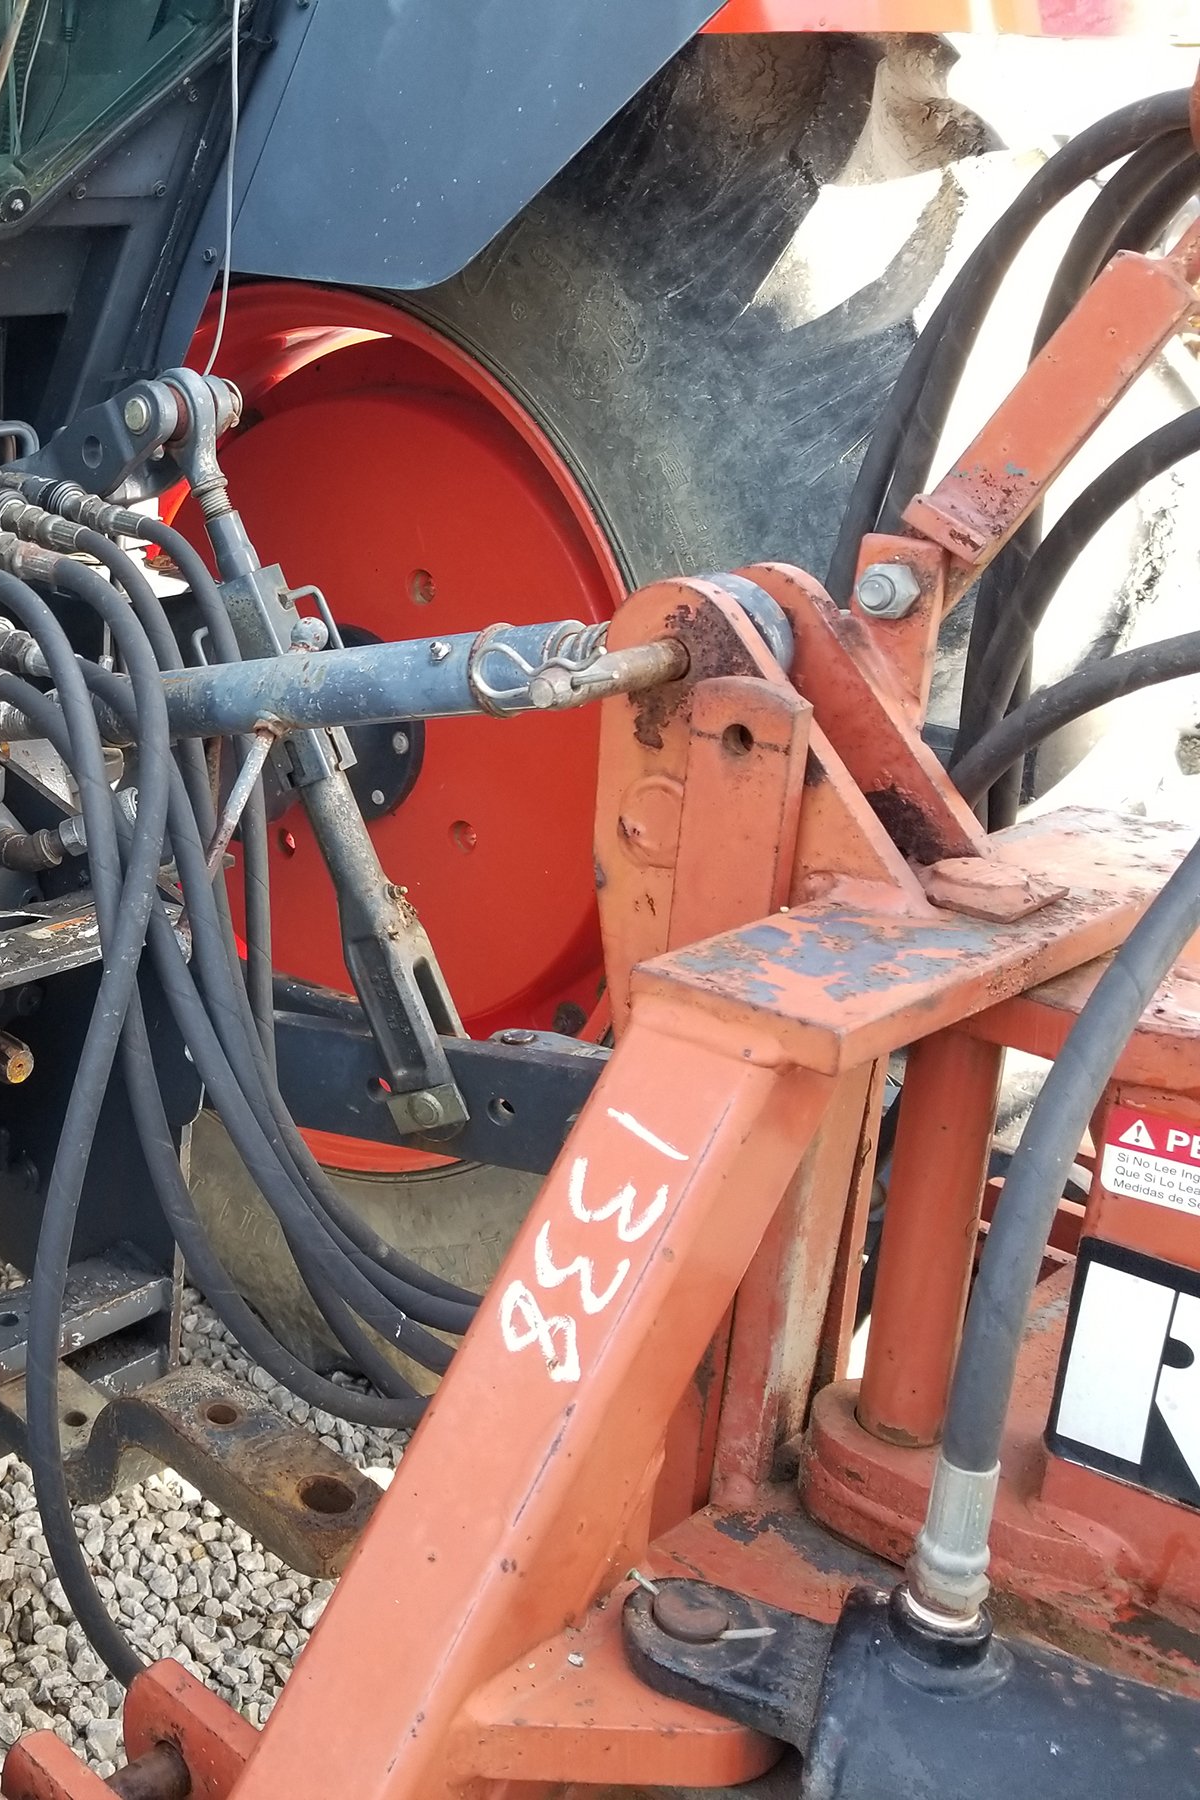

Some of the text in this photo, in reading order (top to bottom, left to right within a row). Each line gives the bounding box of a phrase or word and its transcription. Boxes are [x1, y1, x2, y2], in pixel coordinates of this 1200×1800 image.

[1117, 1152, 1130, 1163] Si
[1133, 1156, 1150, 1169] No
[1154, 1162, 1177, 1176] Lee
[1115, 1165, 1140, 1179] Que
[1144, 1172, 1157, 1184] Si
[1160, 1177, 1175, 1189] Lo
[1113, 1177, 1165, 1199] Medidas
[1168, 1194, 1184, 1204] de
[498, 1107, 689, 1382] 1338
